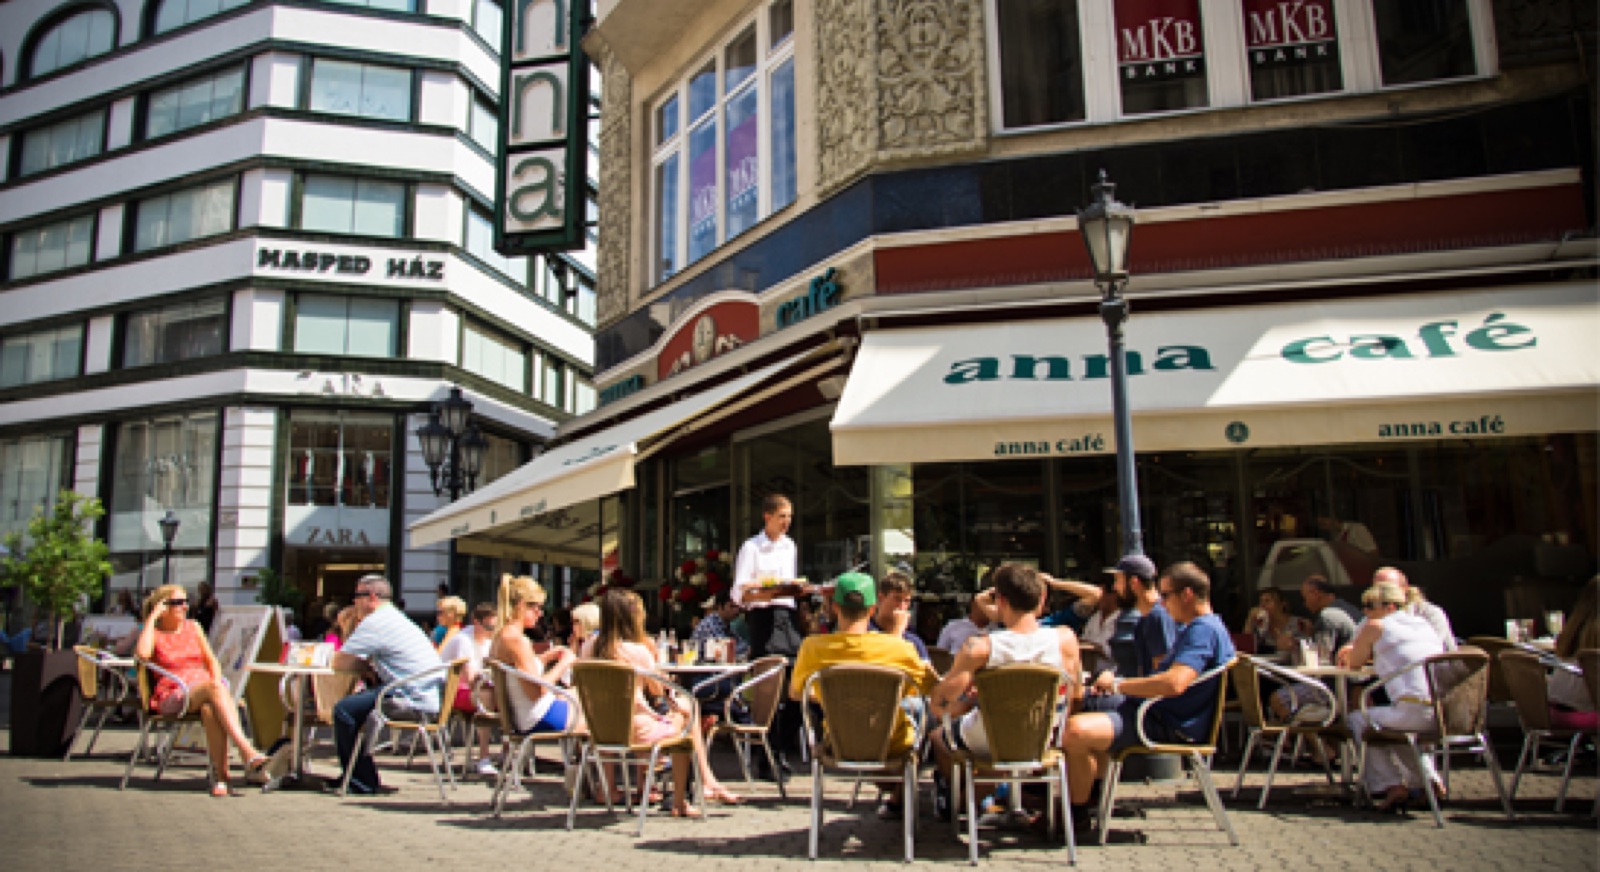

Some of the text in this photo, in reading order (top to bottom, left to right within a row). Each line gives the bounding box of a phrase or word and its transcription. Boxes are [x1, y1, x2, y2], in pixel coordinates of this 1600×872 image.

[1249, 1, 1327, 44] MKB
[1122, 17, 1196, 60] MKB
[1256, 45, 1327, 64] BANK
[1126, 61, 1196, 78] BANK
[258, 247, 445, 279] MASPED HÁZ
[776, 267, 841, 328] café
[943, 312, 1537, 384] anna café
[1378, 415, 1505, 437] anna café
[994, 433, 1105, 455] anna café
[306, 526, 370, 545] ZARA
